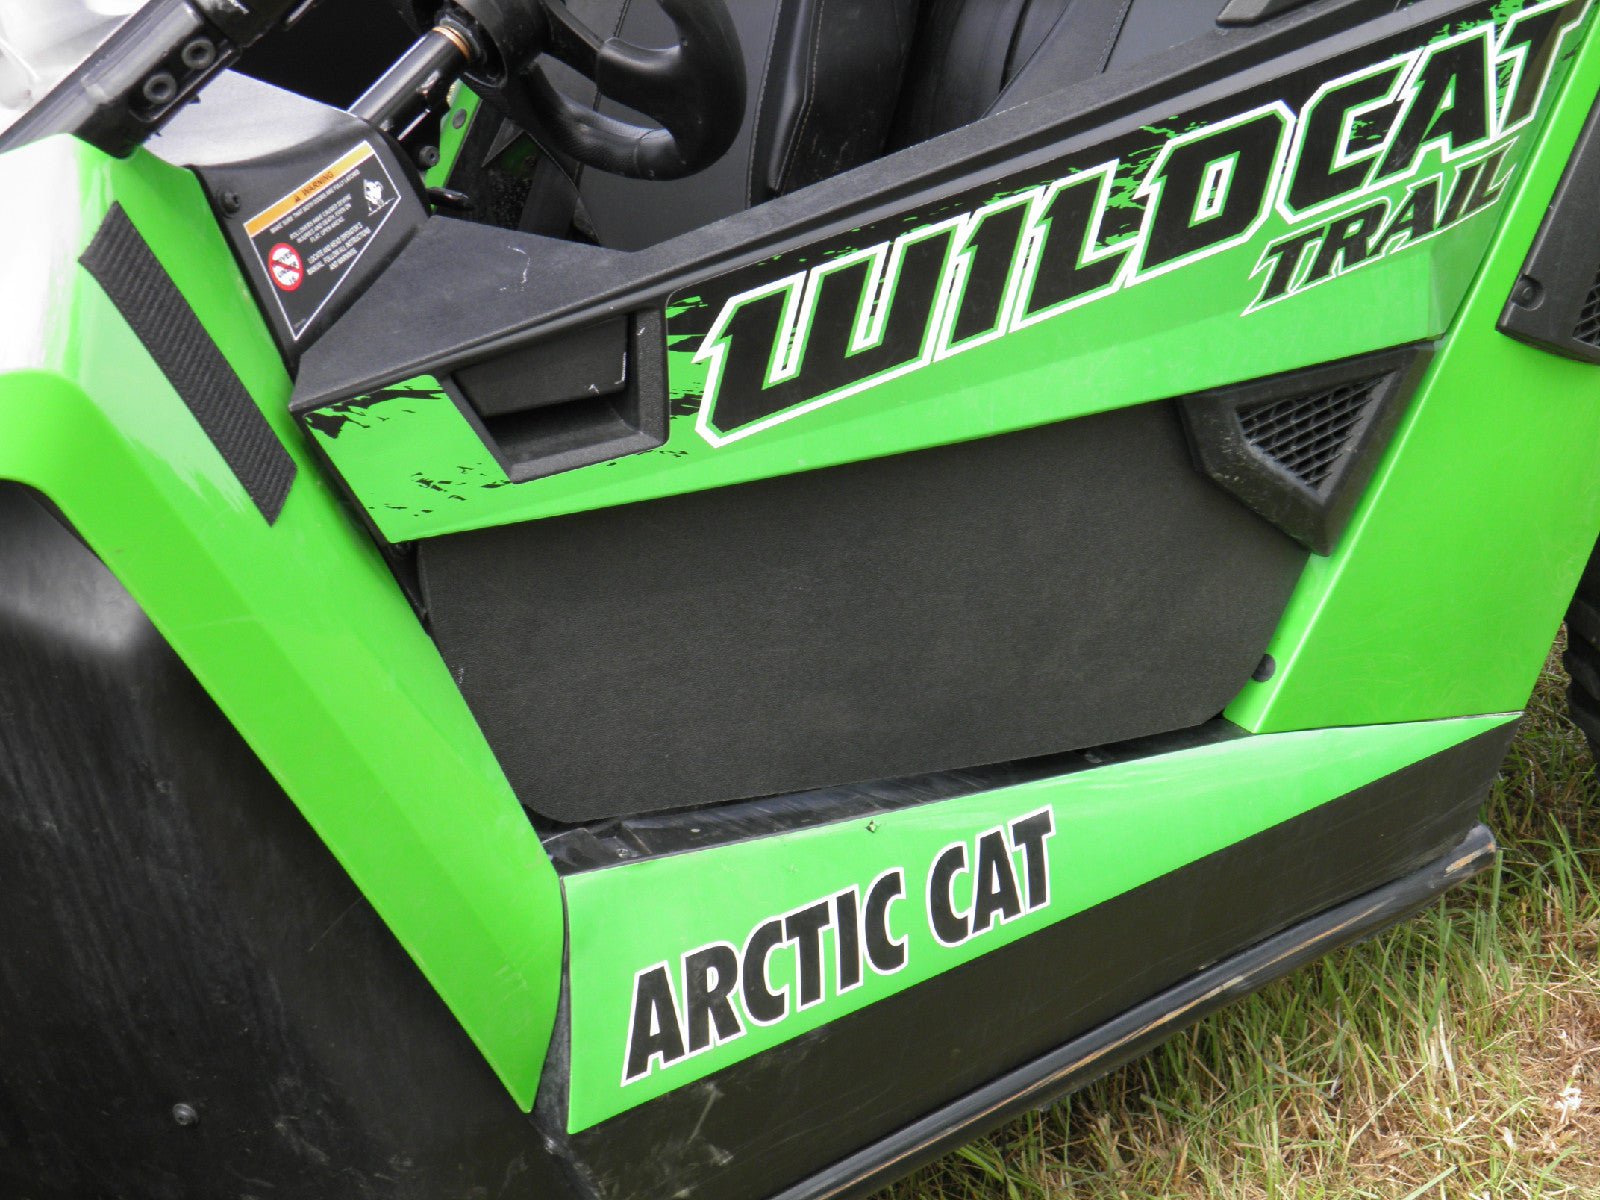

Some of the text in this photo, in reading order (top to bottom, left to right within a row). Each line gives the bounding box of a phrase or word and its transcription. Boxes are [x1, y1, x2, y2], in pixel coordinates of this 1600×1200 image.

[694, 0, 1588, 448] WILDCAT
[1241, 136, 1519, 316] TRAIL
[620, 804, 1056, 1087] ARCTIC CAT
